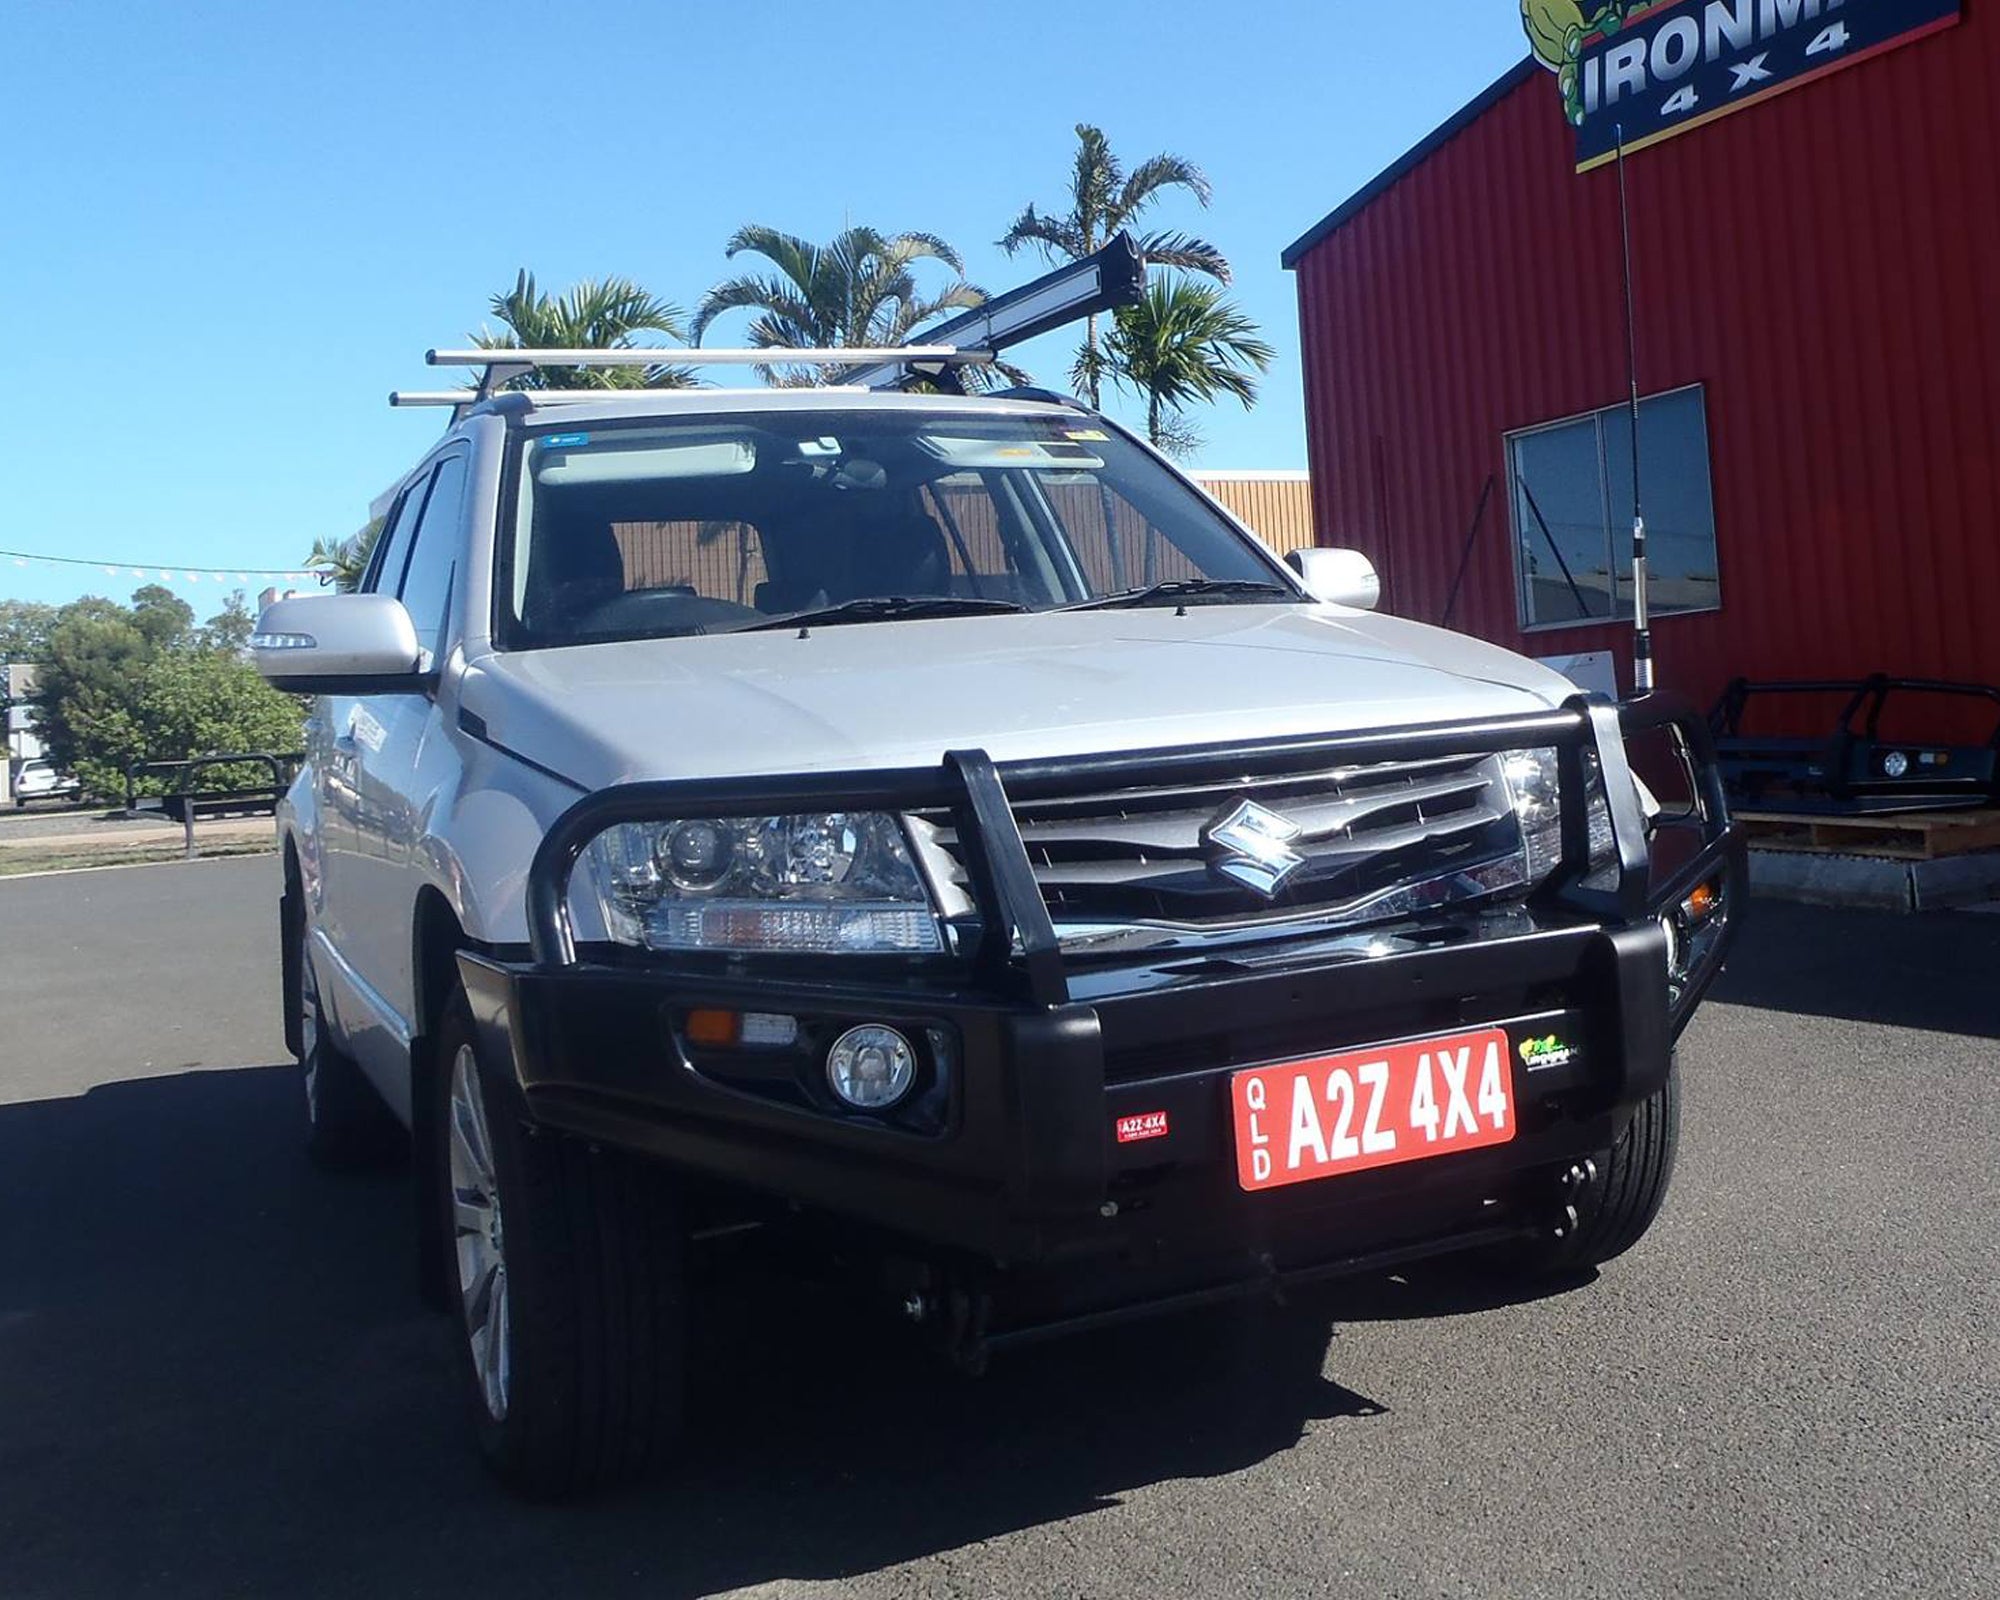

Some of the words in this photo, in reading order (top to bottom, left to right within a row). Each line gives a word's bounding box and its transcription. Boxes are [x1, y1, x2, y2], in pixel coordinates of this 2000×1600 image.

[1584, 0, 1848, 114] IRONM
[1660, 83, 1699, 115] 4
[1805, 20, 1850, 56] 4
[1246, 1077, 1271, 1181] QLD
[1287, 1060, 1396, 1169] A2Z
[1409, 1041, 1507, 1142] 4X4
